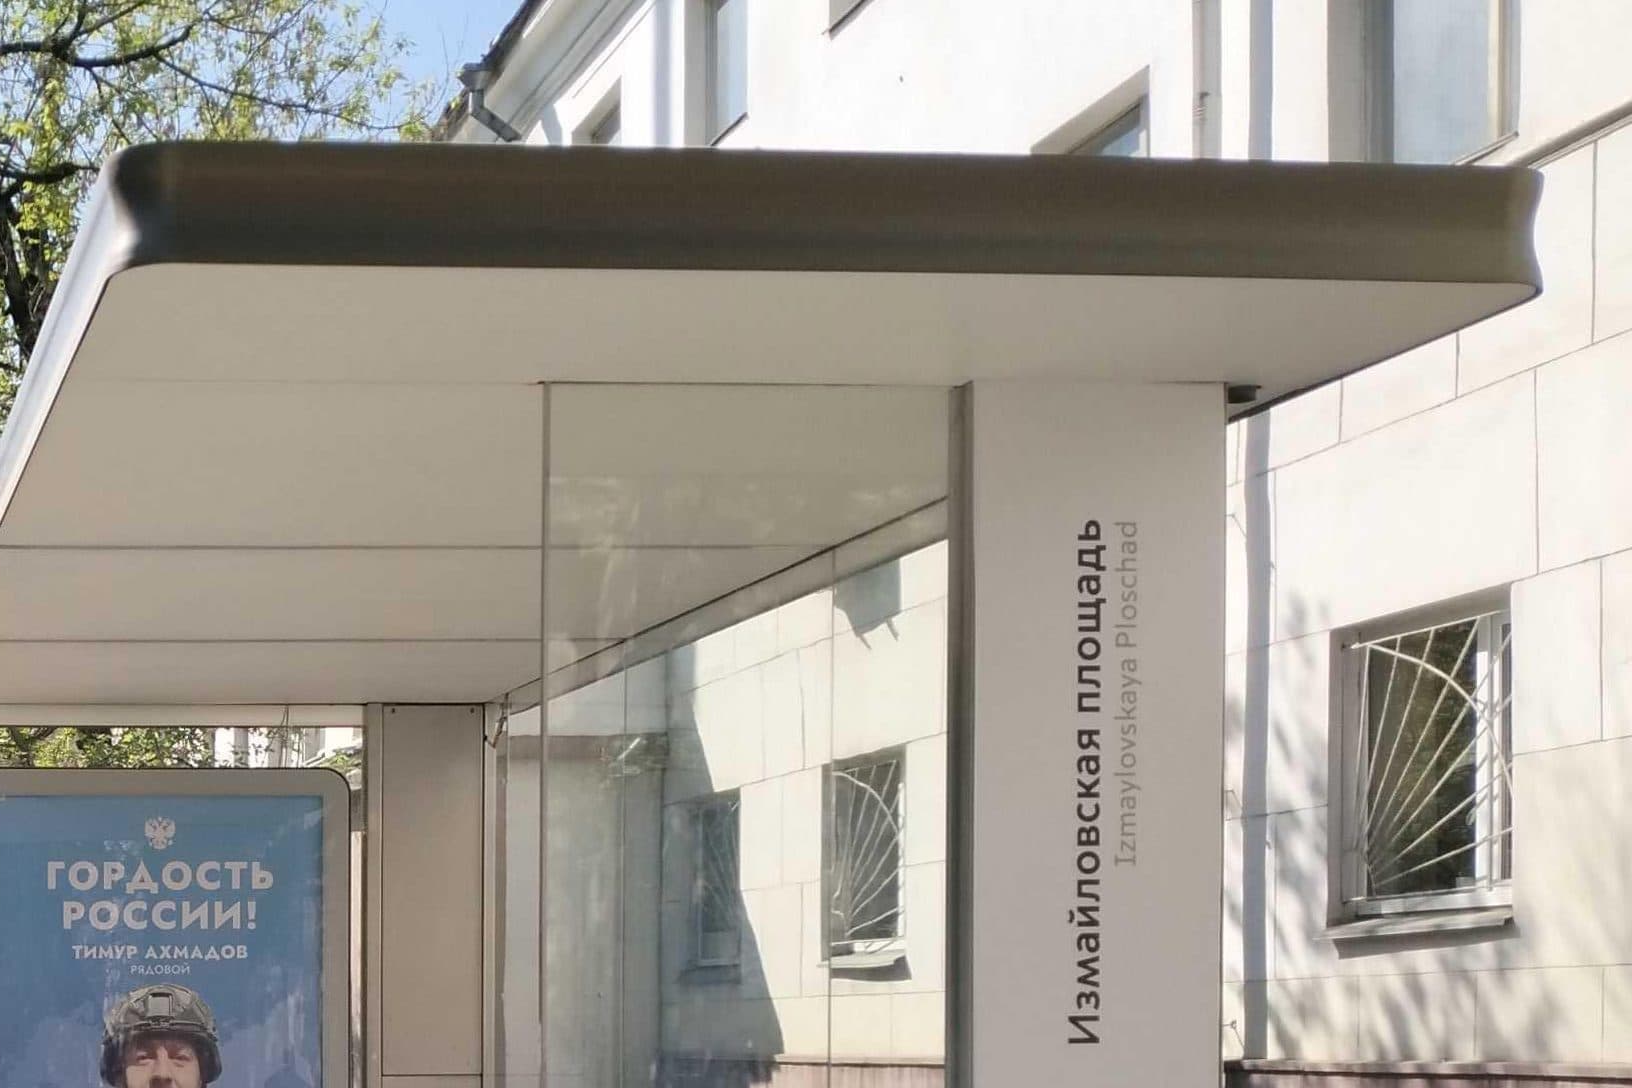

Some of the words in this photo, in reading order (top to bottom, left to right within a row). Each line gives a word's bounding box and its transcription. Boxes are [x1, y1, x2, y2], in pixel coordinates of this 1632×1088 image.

[1077, 519, 1107, 713] площадь
[1114, 521, 1137, 648] Ploschad
[1114, 658, 1142, 867] Izmaylovskaya
[47, 859, 274, 894] ГОРДОСТЬ
[62, 900, 257, 930] РОССИИ!
[1068, 729, 1101, 1044] Измайловская
[71, 945, 138, 960] ТИМУР
[145, 945, 249, 960] АХМАДОВ
[130, 962, 191, 976] РЯДОВОЙ
